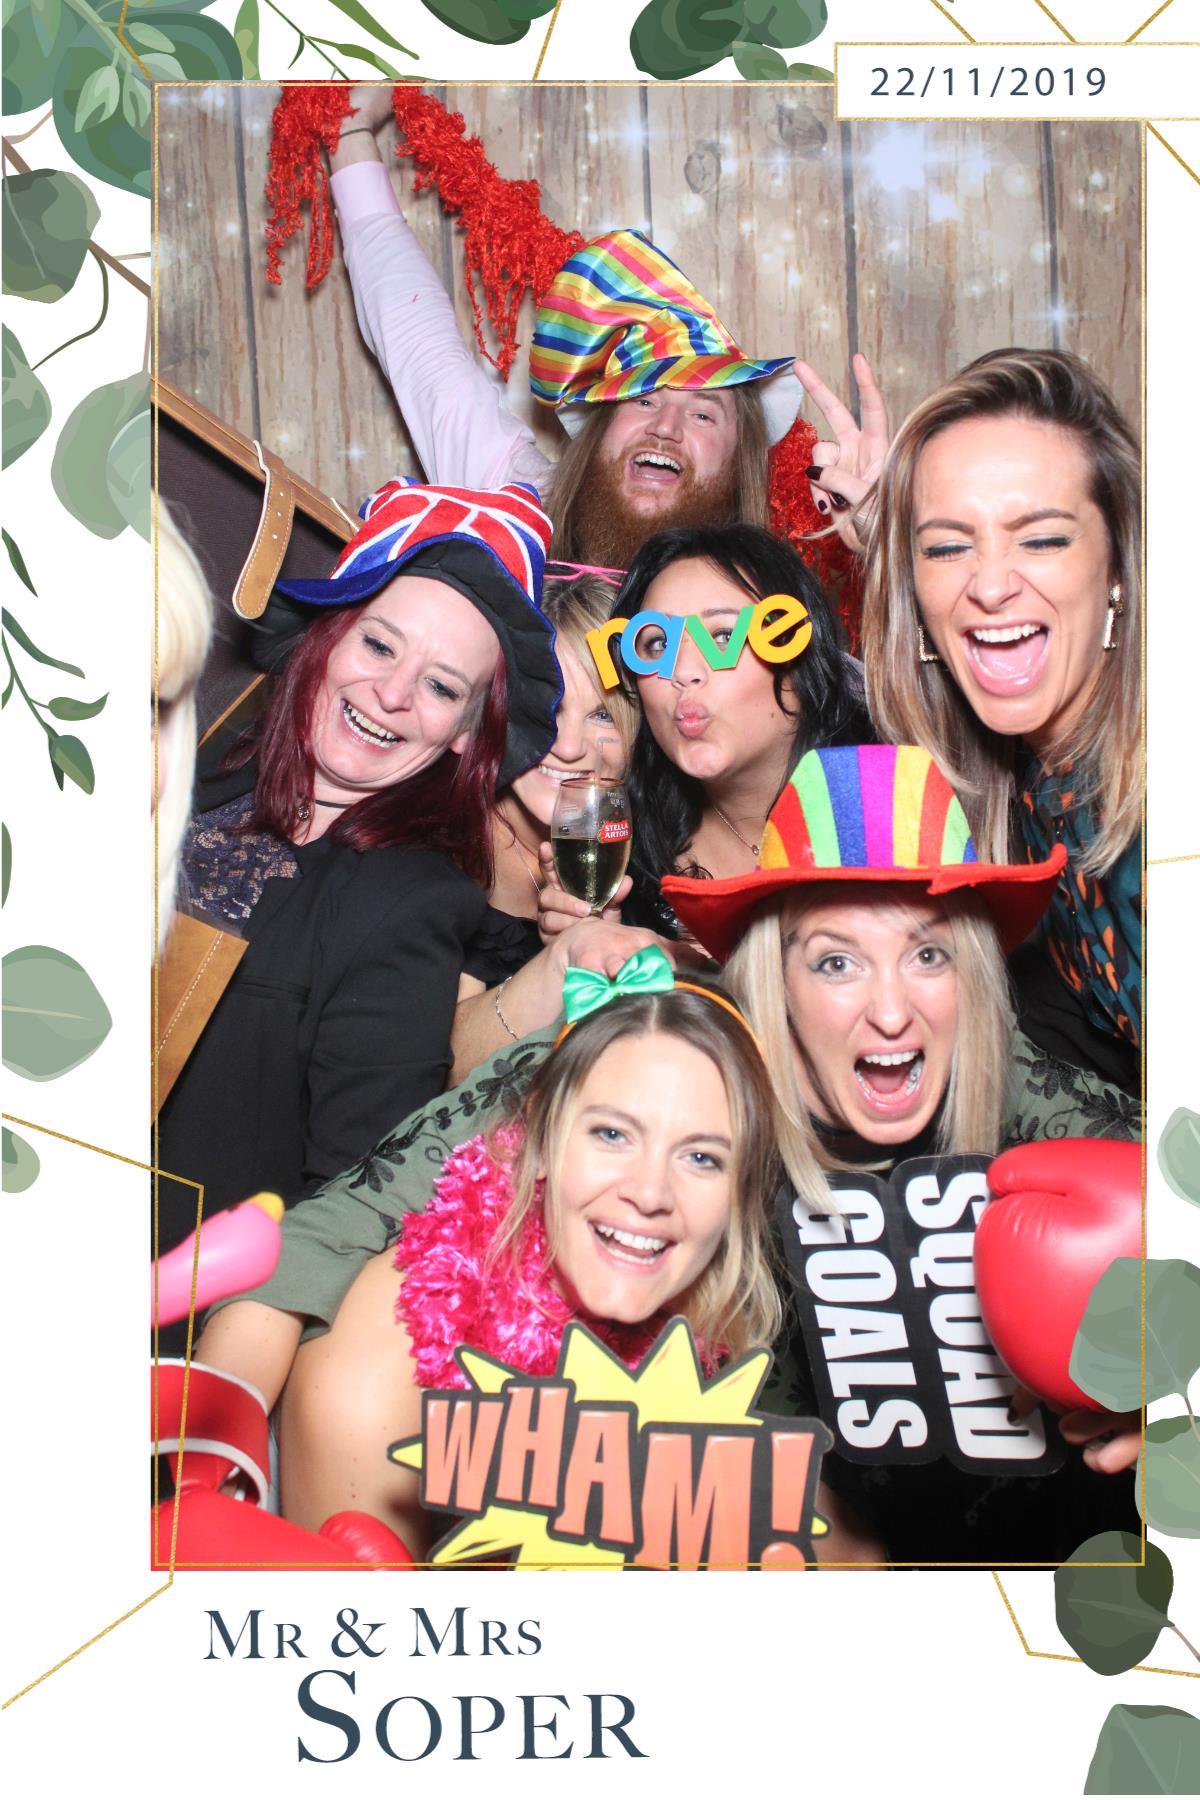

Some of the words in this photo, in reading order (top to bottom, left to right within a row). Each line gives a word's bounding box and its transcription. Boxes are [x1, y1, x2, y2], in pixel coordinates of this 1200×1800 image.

[586, 594, 813, 690] rave
[604, 823, 629, 832] STELLA
[792, 1189, 929, 1449] GOALS
[905, 1172, 1047, 1460] SQUAD
[425, 1387, 815, 1571] WHAM!
